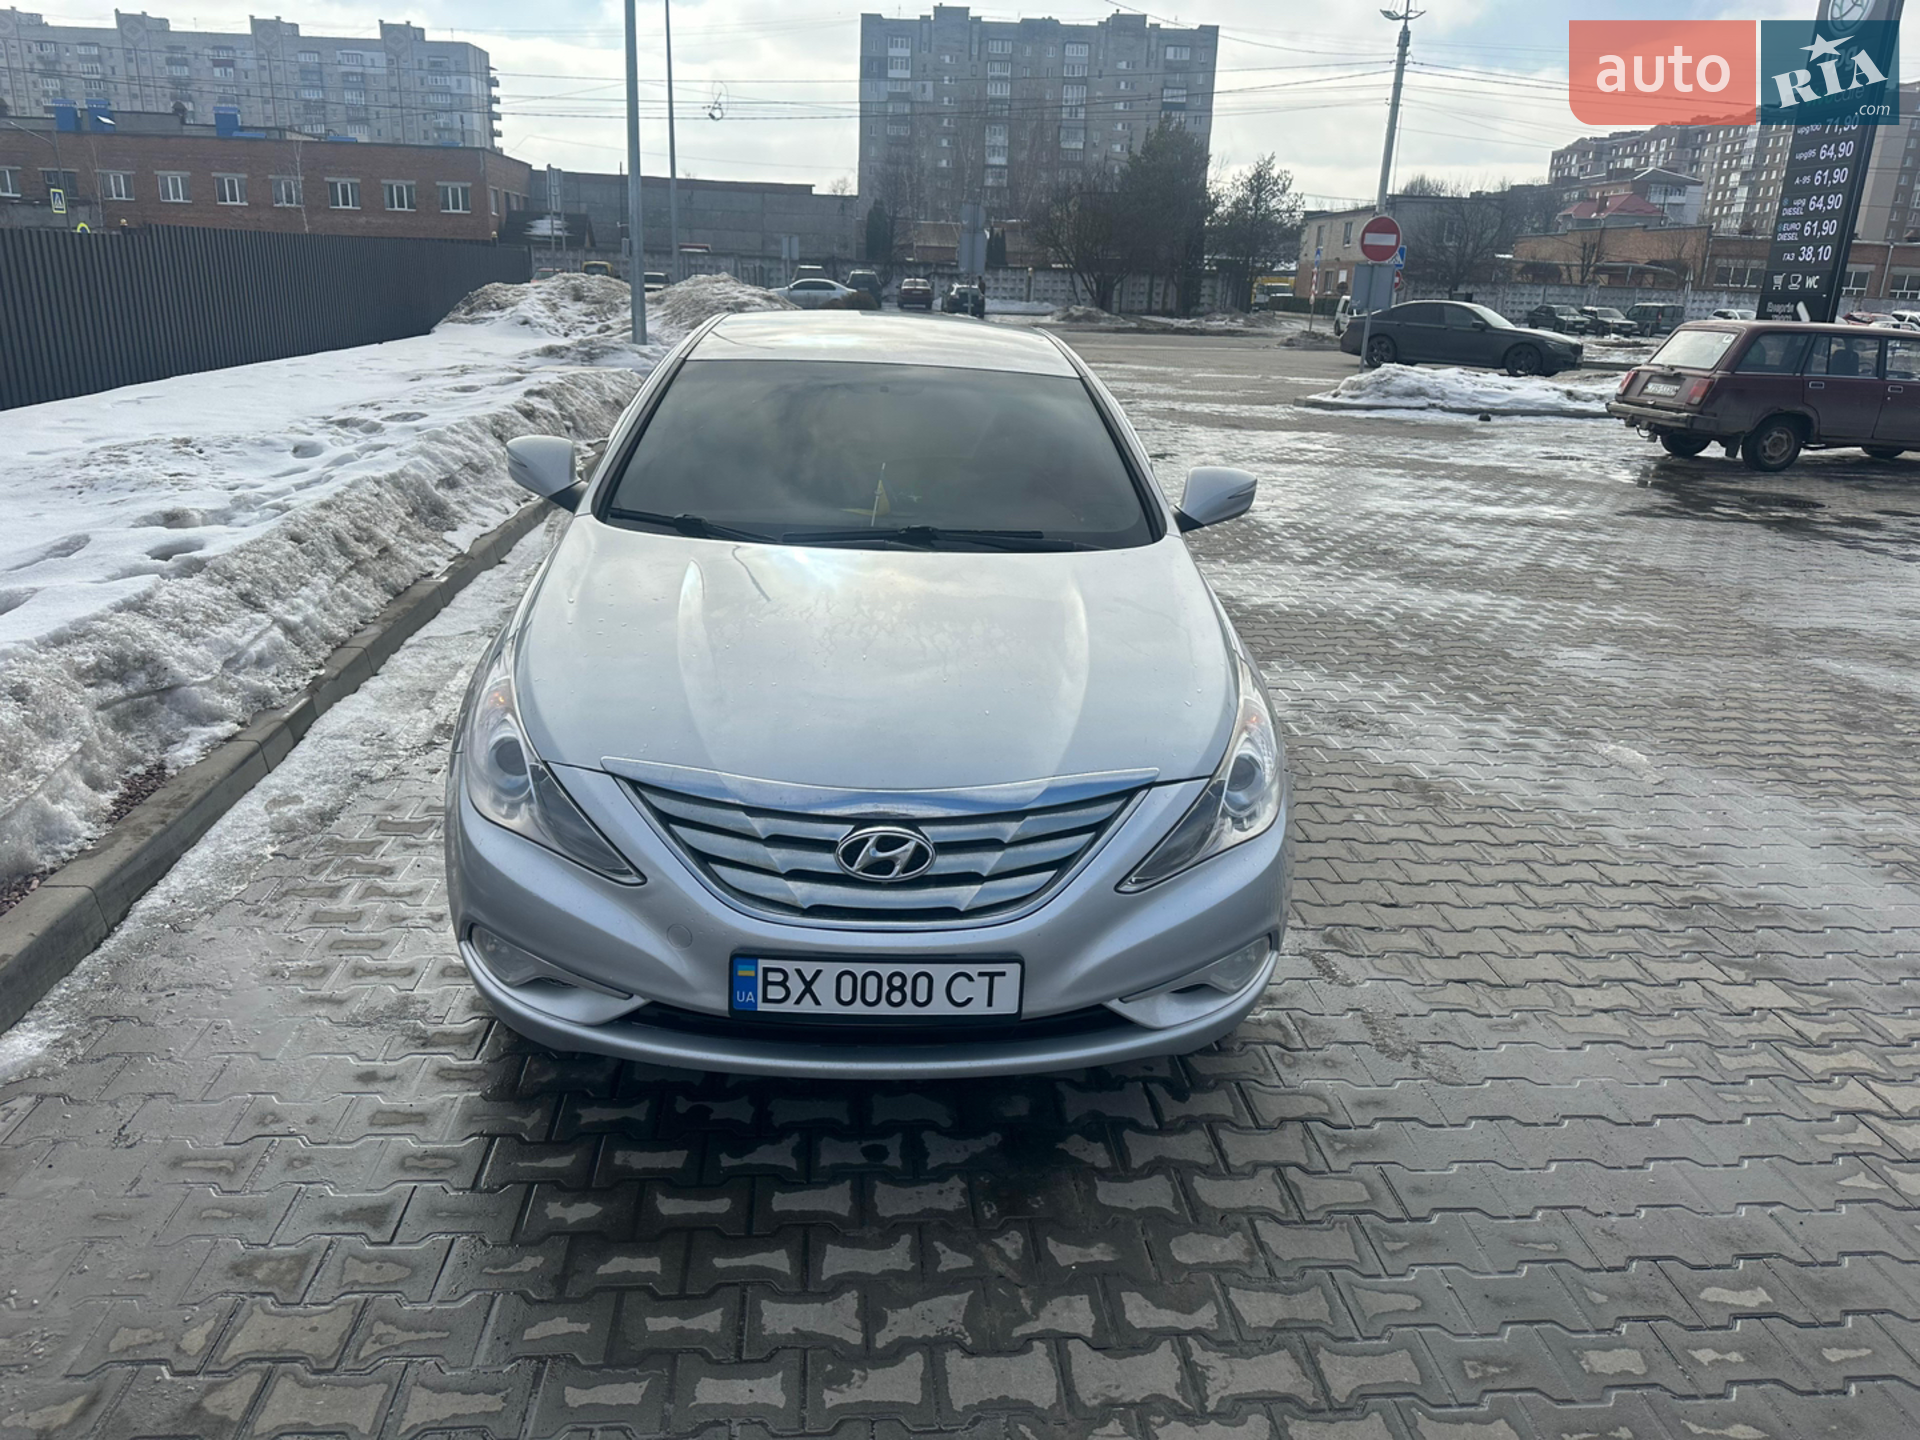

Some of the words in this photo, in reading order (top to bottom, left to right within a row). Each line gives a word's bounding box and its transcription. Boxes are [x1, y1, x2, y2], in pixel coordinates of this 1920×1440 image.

[1825, 115, 1860, 135] 71,90
[1795, 149, 1817, 160] upg95
[1819, 140, 1854, 161] 64,90
[1814, 167, 1849, 187] 61,90
[1782, 206, 1804, 216] DIESEL
[1792, 198, 1806, 207] upg
[1808, 193, 1843, 213] 64,90
[1777, 232, 1799, 241] DIESEL
[1782, 222, 1802, 231] EURO
[1803, 219, 1838, 239] 61,90
[1782, 252, 1796, 261] ГАЗ
[1798, 245, 1832, 264] 38,10
[1805, 275, 1820, 289] WC
[736, 991, 756, 1003] UA
[761, 966, 824, 1006] BX
[834, 969, 934, 1008] 0080
[944, 971, 1007, 1008] CT
